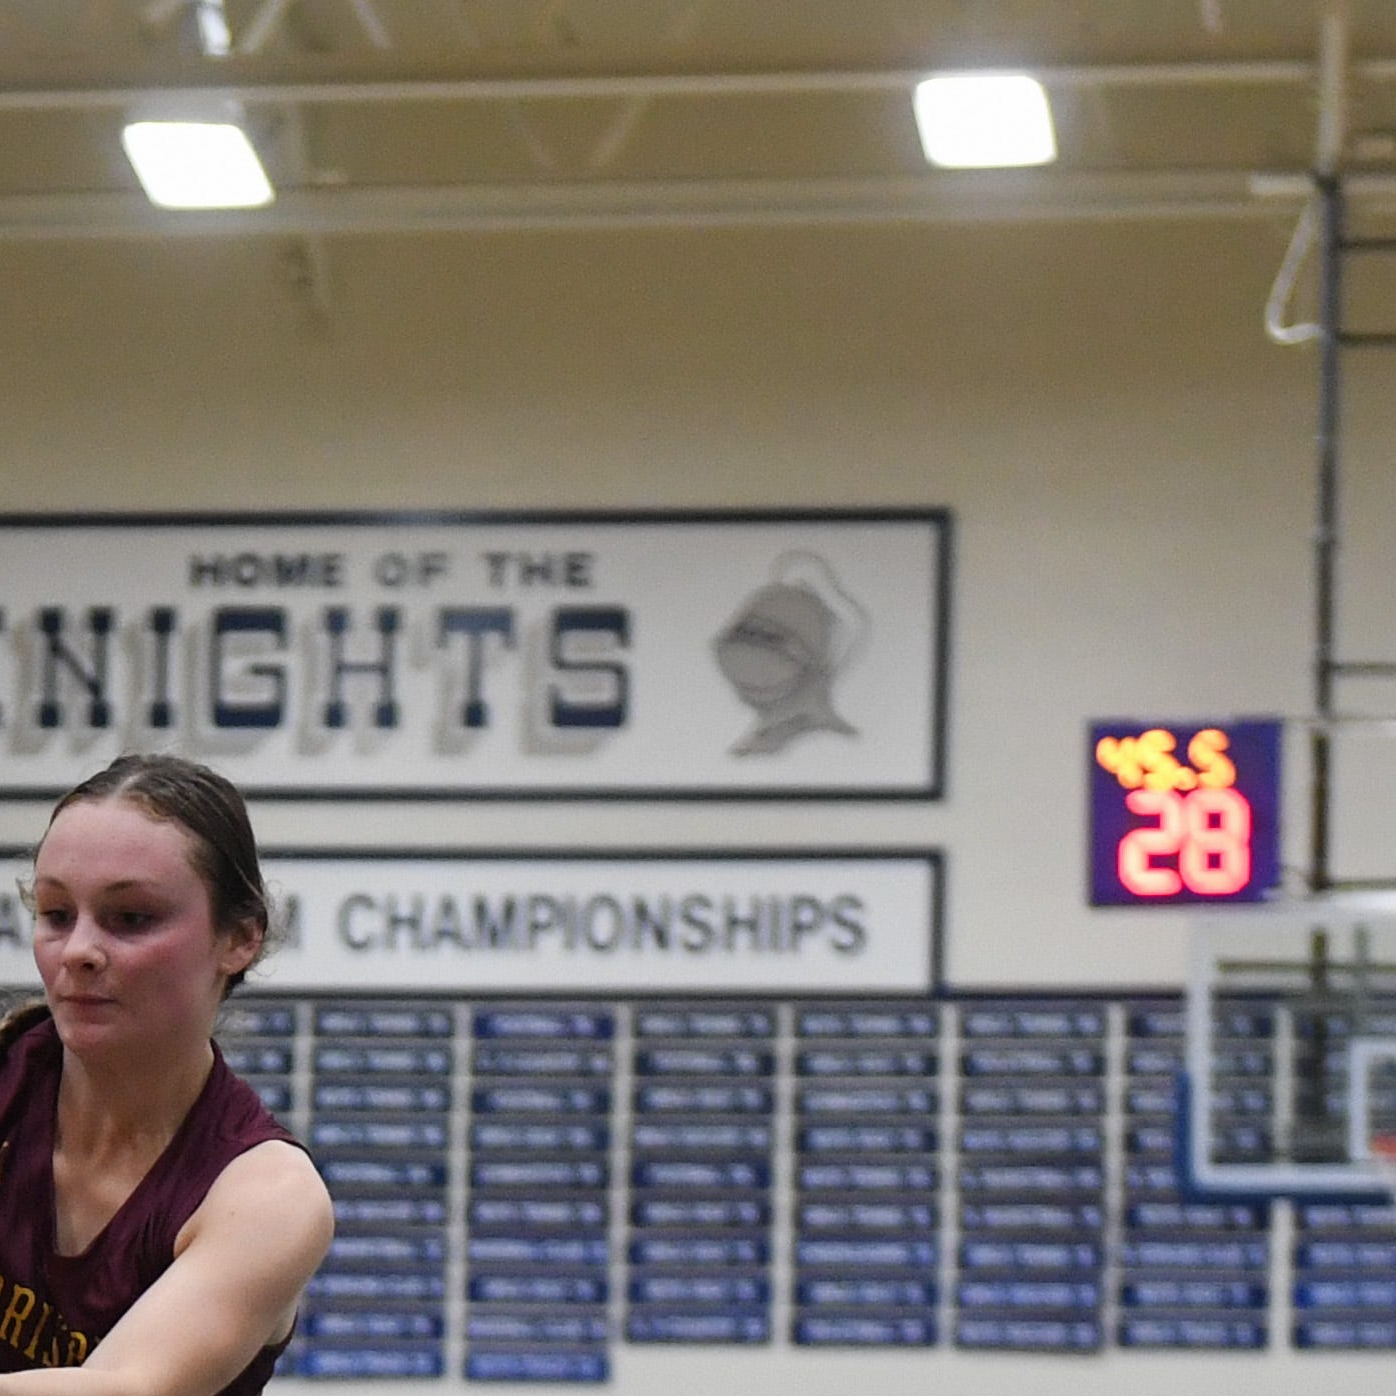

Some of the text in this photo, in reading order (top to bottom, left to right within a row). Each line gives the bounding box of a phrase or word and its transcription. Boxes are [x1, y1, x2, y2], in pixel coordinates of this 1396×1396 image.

[188, 551, 593, 588] HOME OF THE
[1118, 786, 1251, 896] 28
[336, 892, 868, 956] CHAMPIONSHIPS
